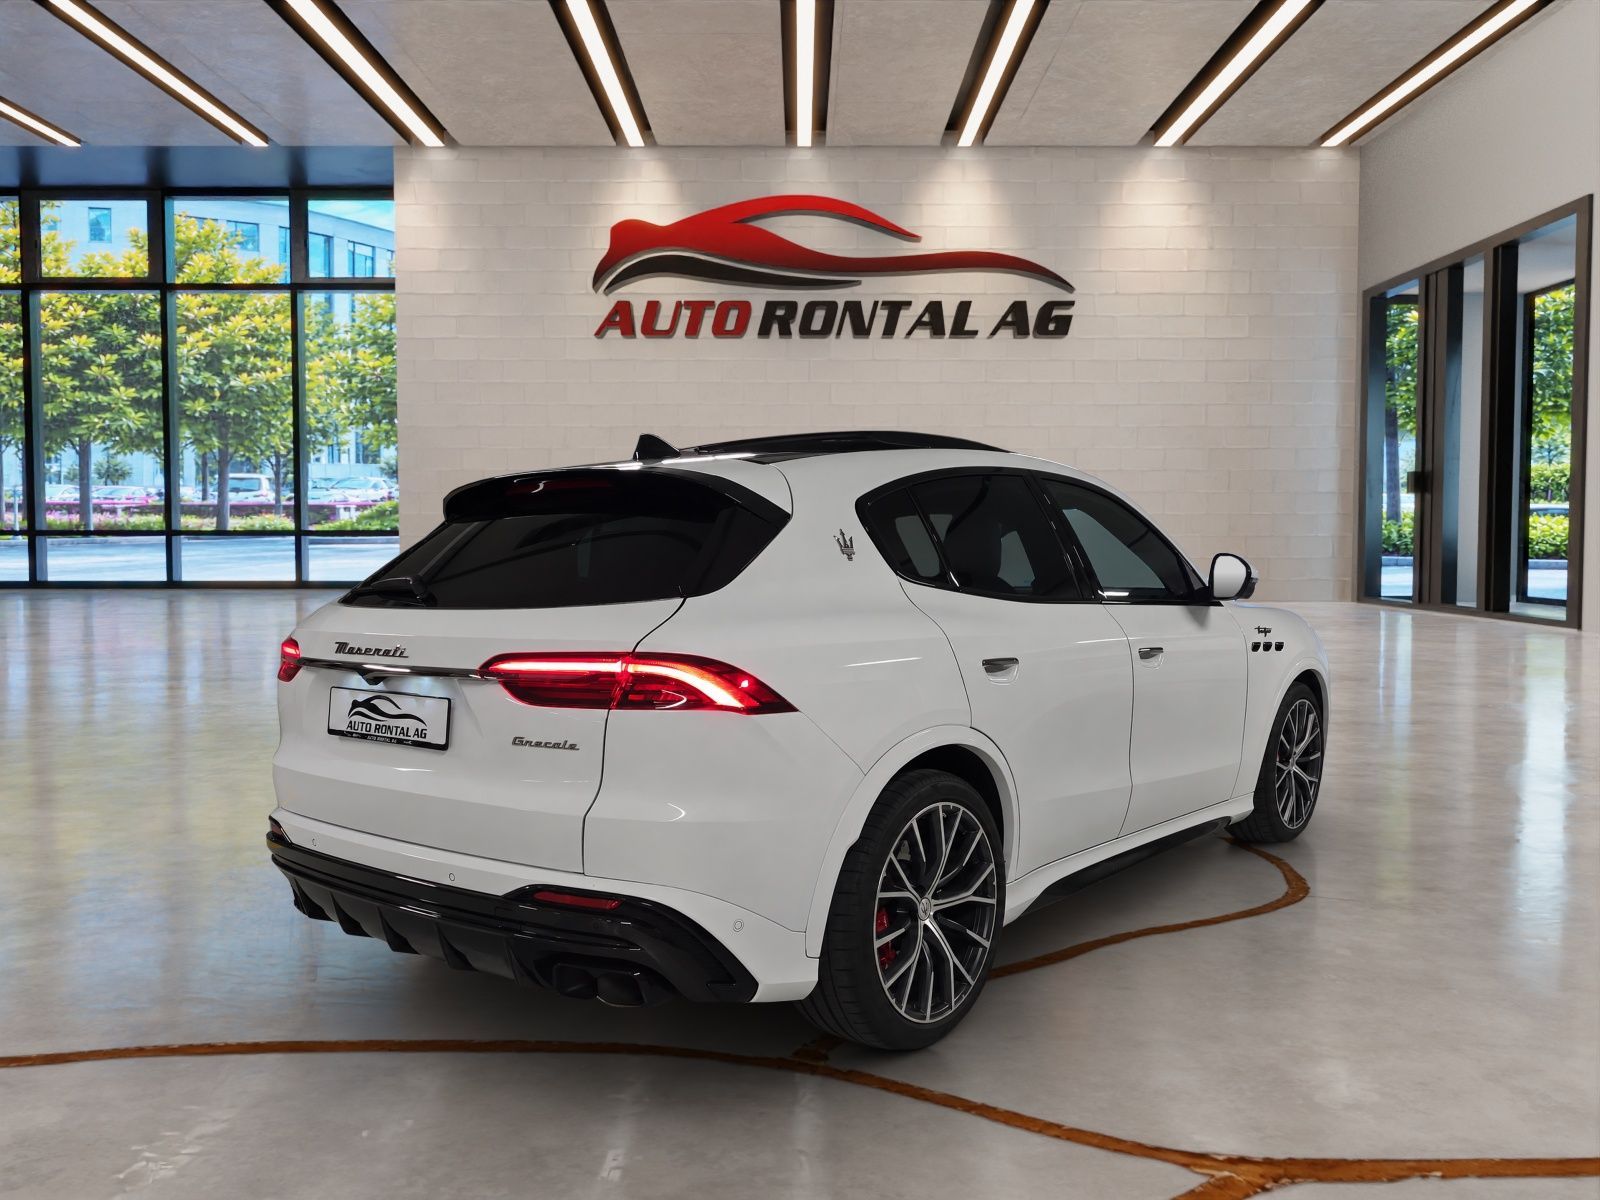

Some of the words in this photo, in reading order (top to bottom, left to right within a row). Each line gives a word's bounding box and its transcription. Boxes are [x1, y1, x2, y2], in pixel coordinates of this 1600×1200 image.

[594, 300, 752, 339] AUTO
[757, 300, 979, 339] RONTAL
[989, 300, 1076, 339] AG
[334, 641, 409, 658] Maserati
[346, 720, 371, 733] AUTO
[374, 723, 411, 738] RONTAL
[413, 727, 428, 739] AG
